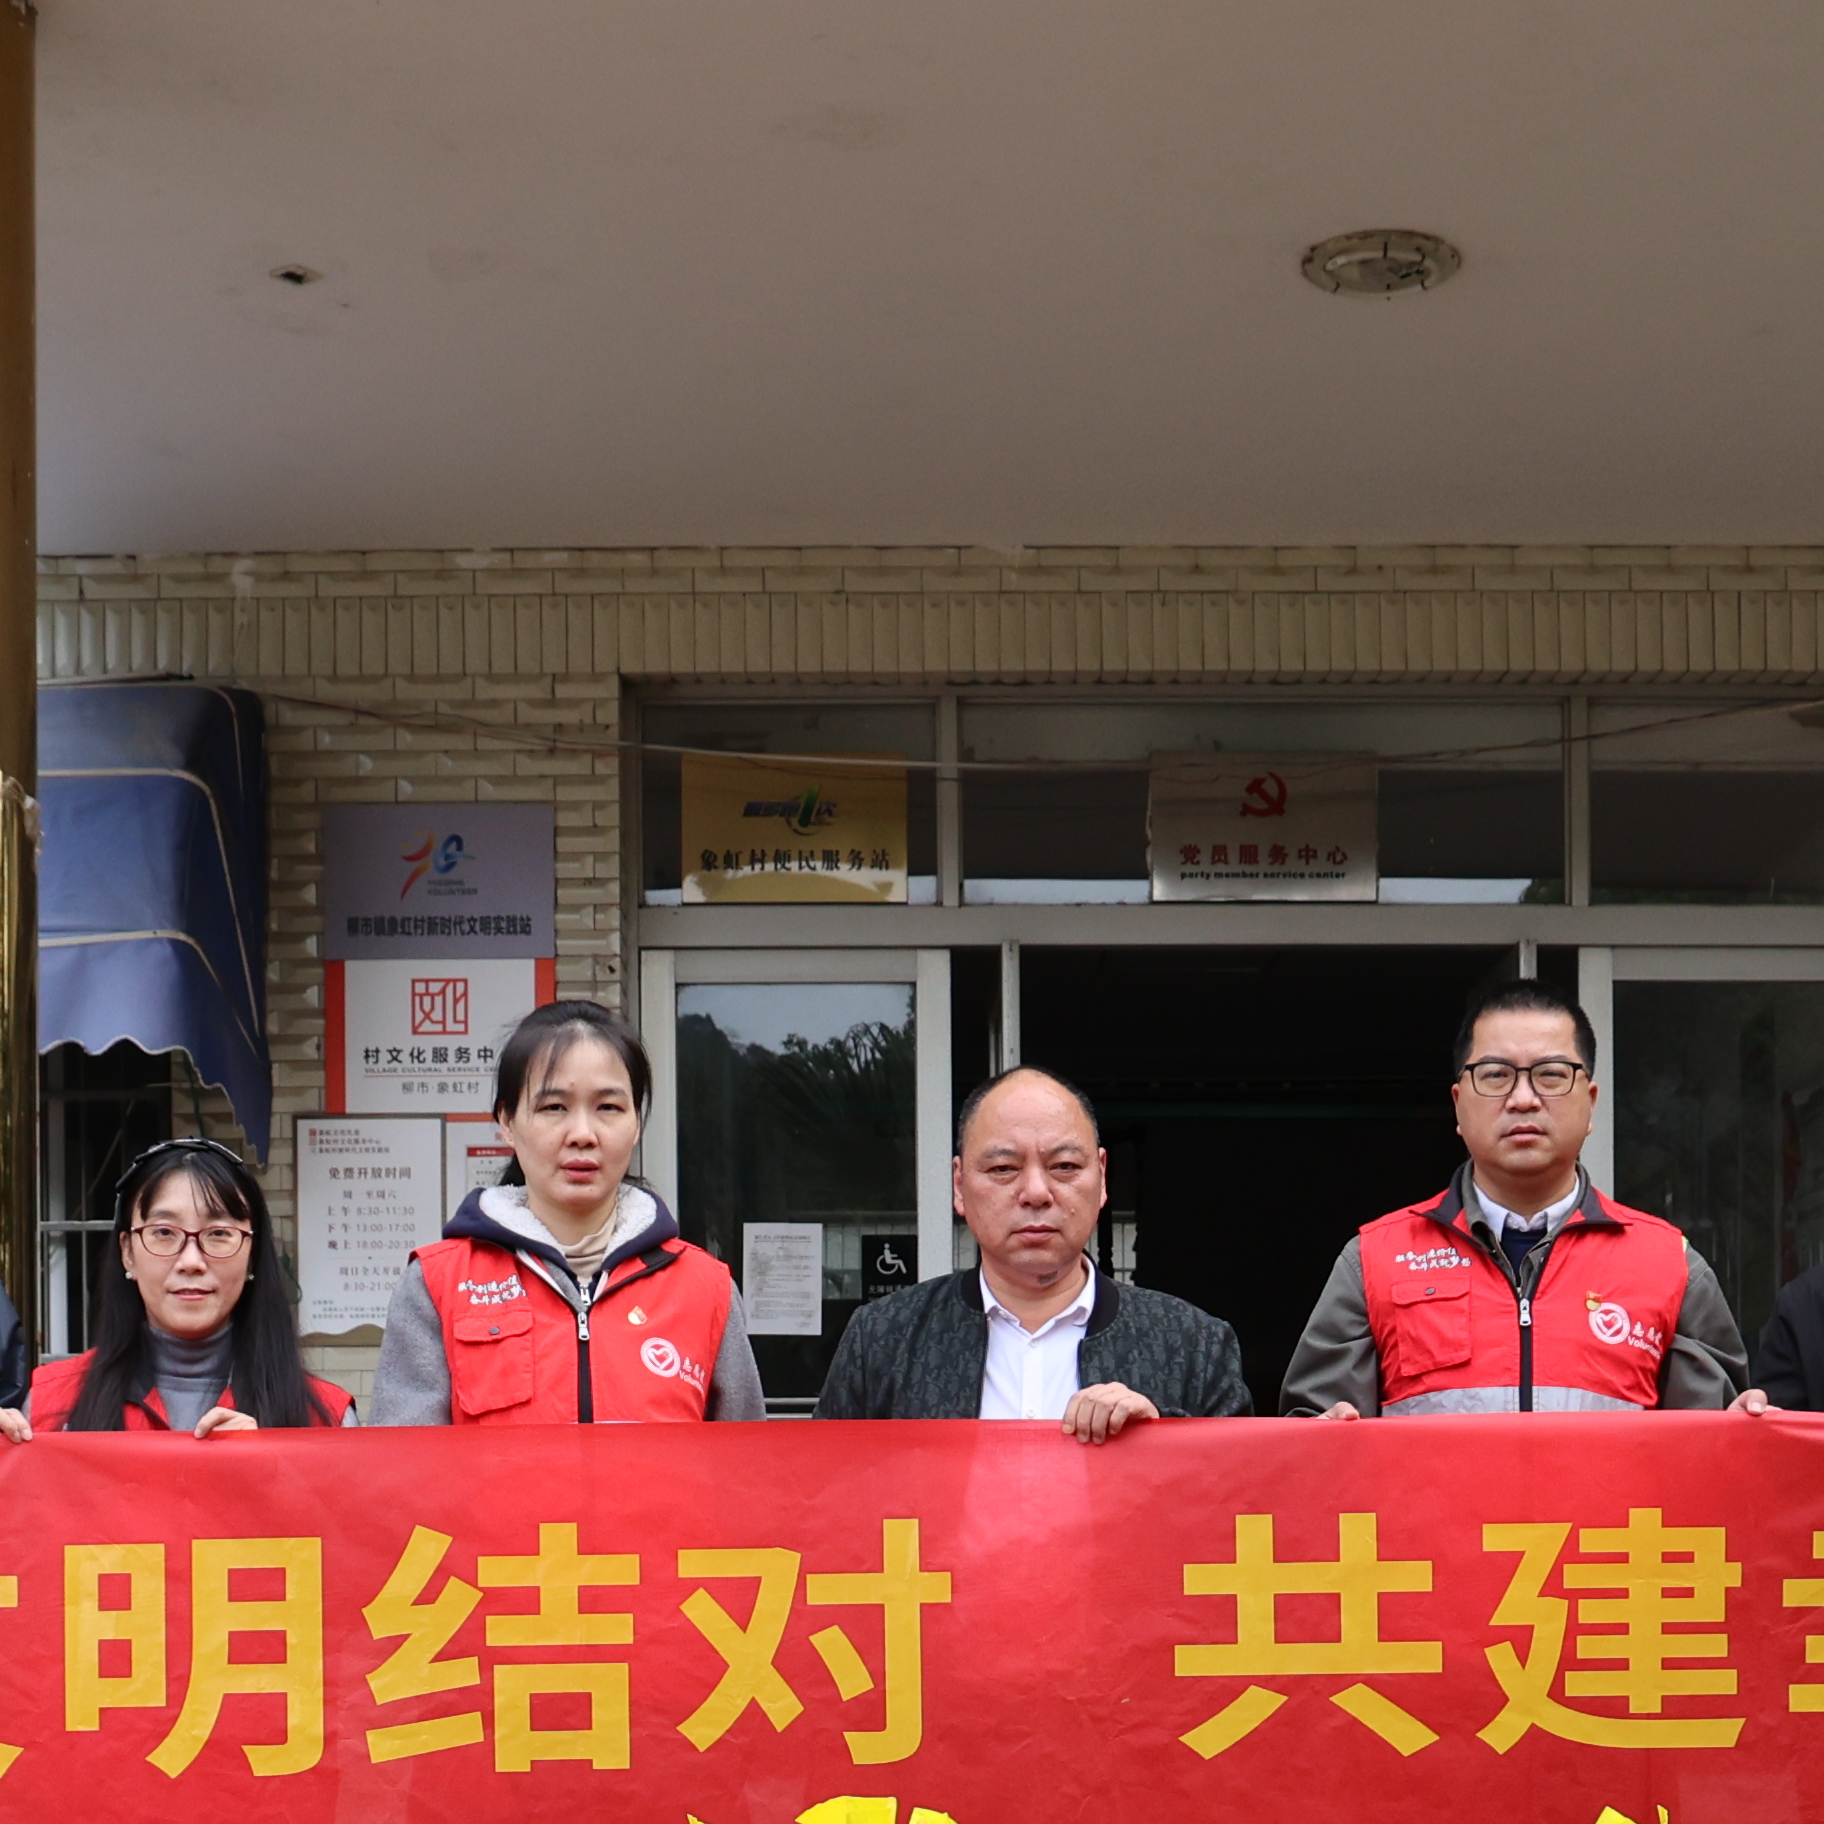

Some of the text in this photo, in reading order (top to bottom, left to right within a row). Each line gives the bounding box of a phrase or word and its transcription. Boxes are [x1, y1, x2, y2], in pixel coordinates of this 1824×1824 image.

[700, 849, 890, 871] 象虹村便民服务站
[1179, 844, 1348, 865] 党员服务中心
[1180, 872, 1210, 880] party
[1214, 871, 1259, 879] member
[1263, 871, 1305, 879] service
[347, 915, 532, 936] 柳市镇象虹村新时代文明实践站
[363, 1047, 494, 1065] 村文化服务中
[329, 1167, 412, 1179] 免费开放时间
[356, 1206, 415, 1215] 8:30-11:30
[356, 1223, 415, 1232] 13:00-17:00
